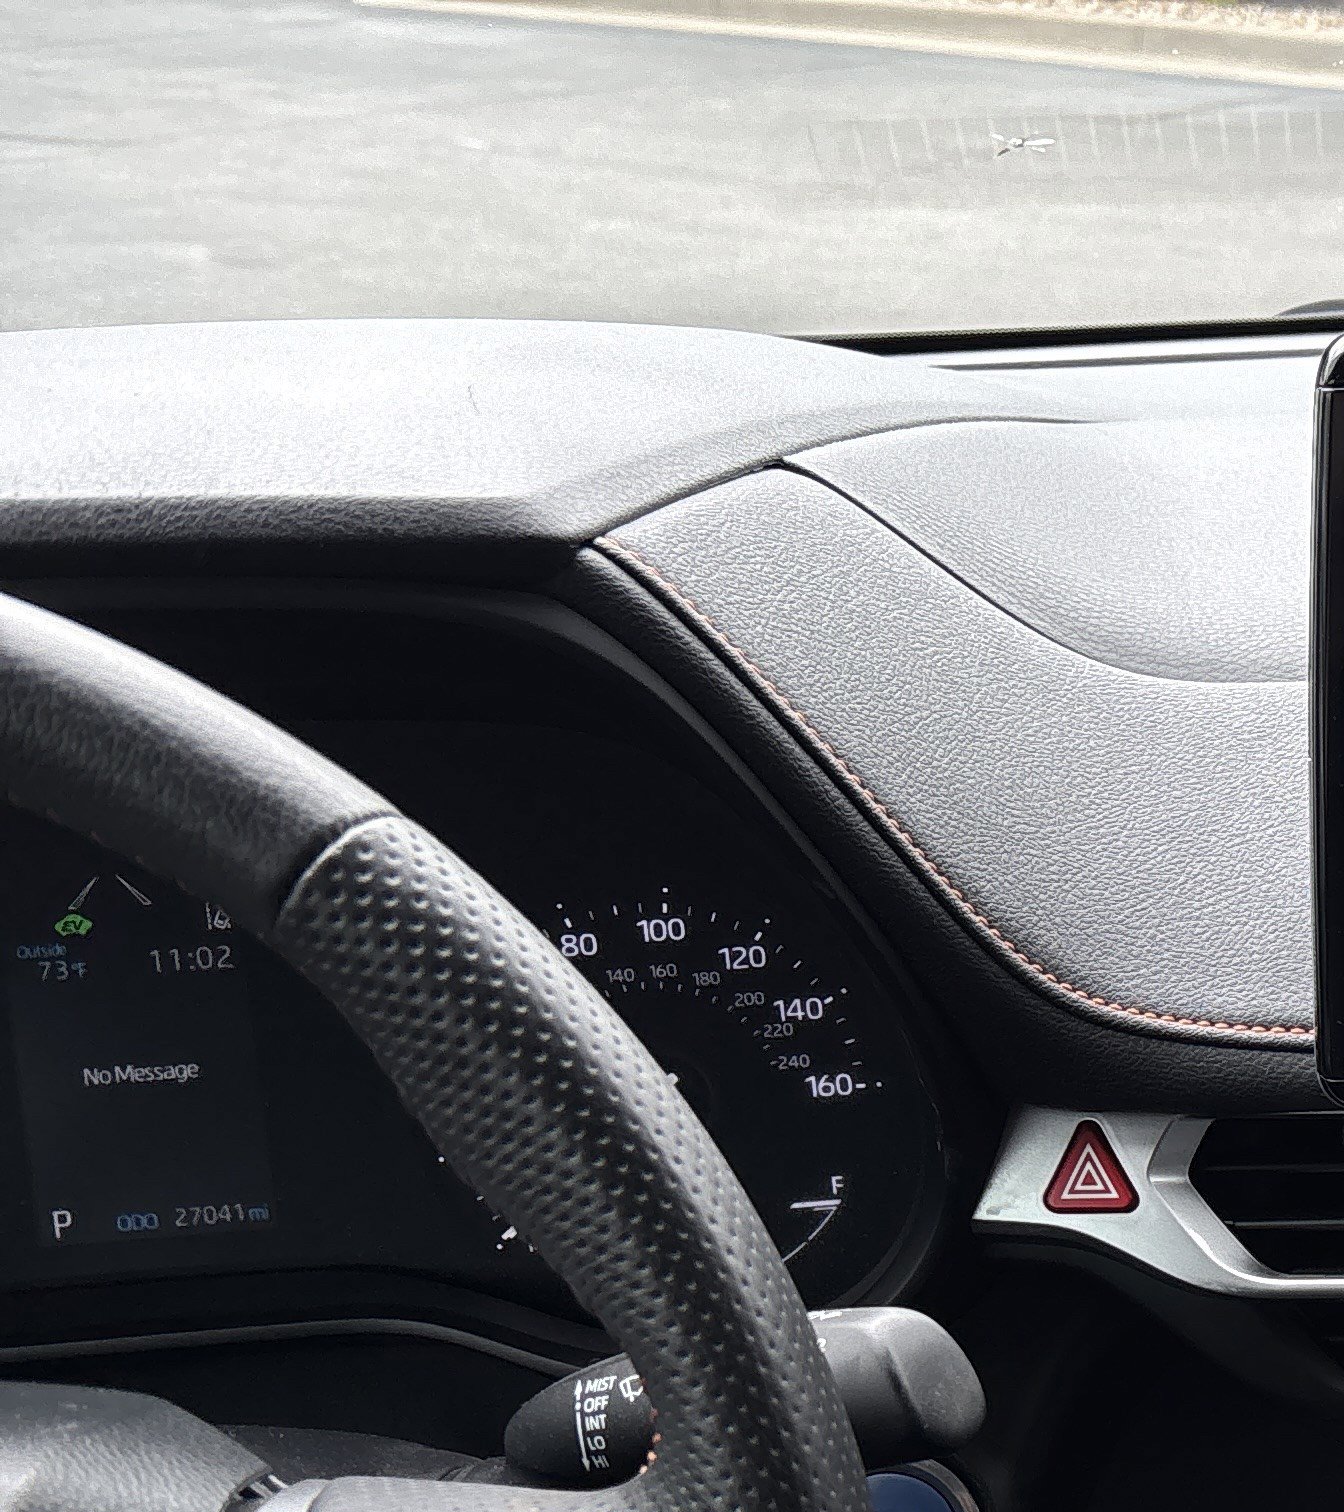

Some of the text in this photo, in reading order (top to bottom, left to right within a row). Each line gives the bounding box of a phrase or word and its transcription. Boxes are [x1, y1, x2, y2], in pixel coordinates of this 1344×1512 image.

[637, 917, 686, 944] 100
[560, 933, 599, 957] 80
[150, 945, 235, 974] 11:02
[718, 945, 767, 971] 120
[606, 967, 635, 983] 140
[649, 963, 678, 979] 160
[692, 970, 721, 986] 180
[734, 991, 765, 1006] 200
[773, 996, 824, 1022] 140
[763, 1023, 794, 1038] 220
[777, 1054, 811, 1070] 240
[82, 1062, 200, 1087] No Message
[804, 1072, 853, 1098] 160
[831, 1175, 845, 1195] F
[51, 1208, 73, 1240] P
[174, 1204, 246, 1228] 27041
[584, 1375, 618, 1395] MIST
[583, 1394, 610, 1414] OFF
[584, 1413, 608, 1432] INT
[586, 1435, 607, 1452] LO
[591, 1454, 610, 1469] HI
